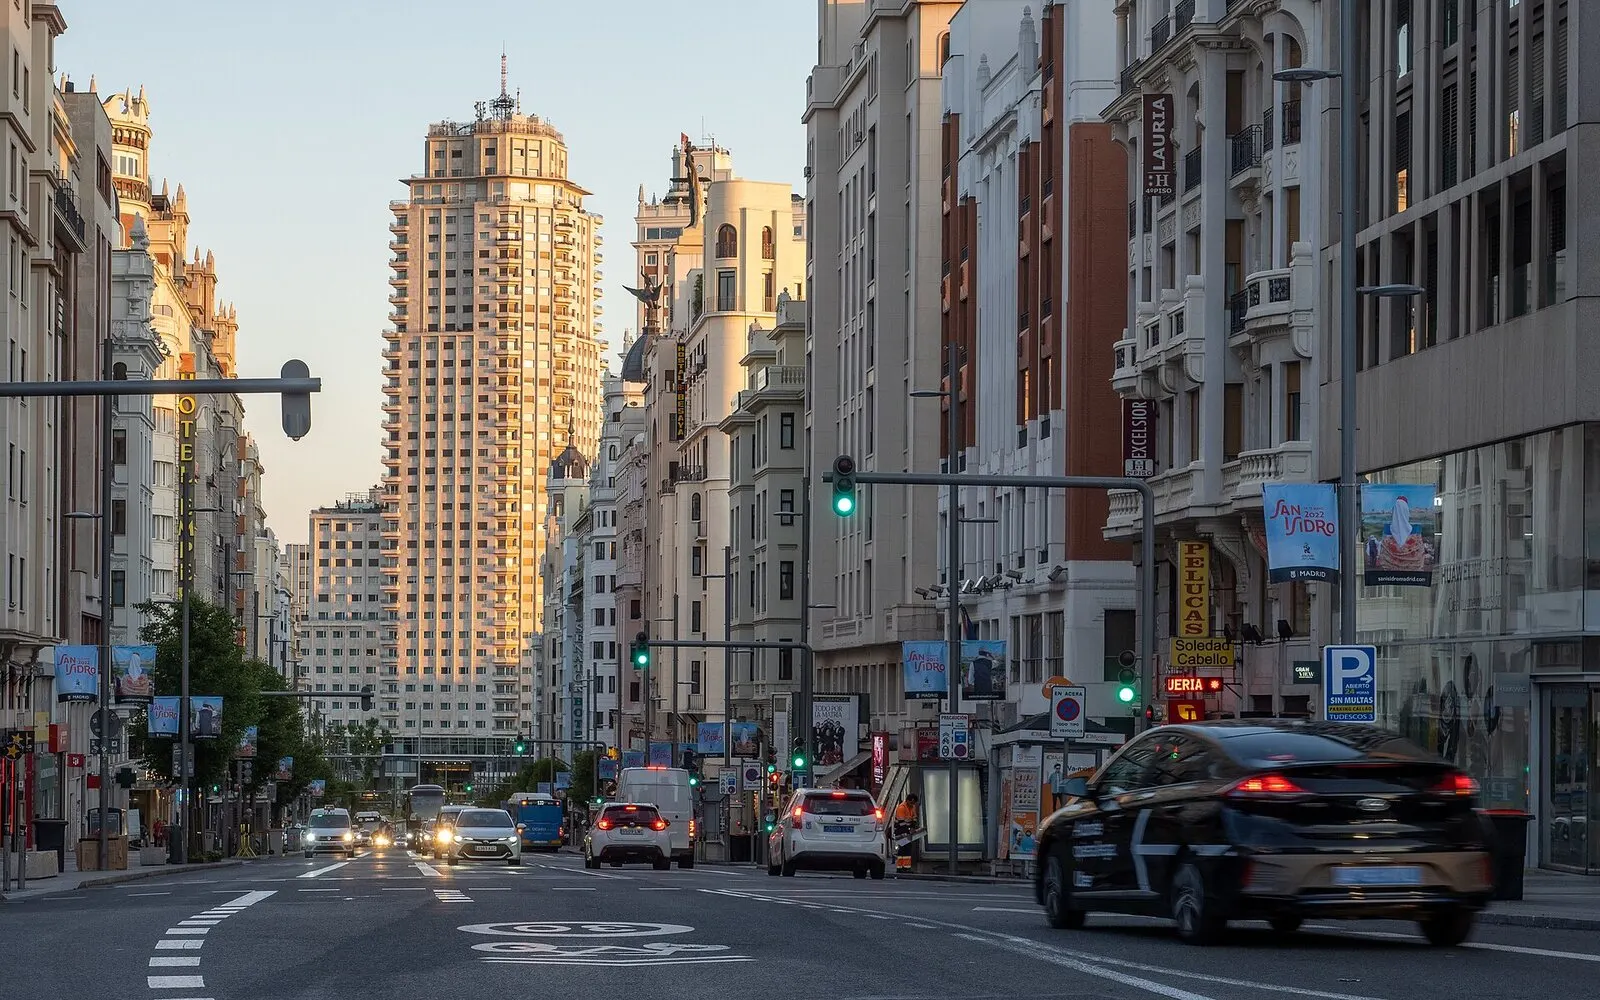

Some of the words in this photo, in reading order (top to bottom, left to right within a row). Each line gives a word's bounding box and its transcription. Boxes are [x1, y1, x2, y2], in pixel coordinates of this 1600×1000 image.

[1152, 97, 1165, 171] LAURIA
[677, 345, 685, 381] HOSTAL
[179, 372, 196, 484] OTEL
[1131, 401, 1147, 458] EXCELSIOR
[1270, 499, 1301, 519] SAN
[1304, 510, 1325, 518] 2022
[1285, 516, 1335, 536] ISIDRO
[1183, 543, 1205, 635] PELUCAS
[1175, 639, 1230, 651] Soledad
[57, 653, 76, 666] SAN
[906, 650, 925, 663] SAN
[1177, 653, 1228, 665] Cabello
[66, 664, 96, 676] ISIDRO
[914, 660, 946, 673] ISIDRO
[1331, 649, 1370, 695] P
[1168, 678, 1203, 691] UERIA
